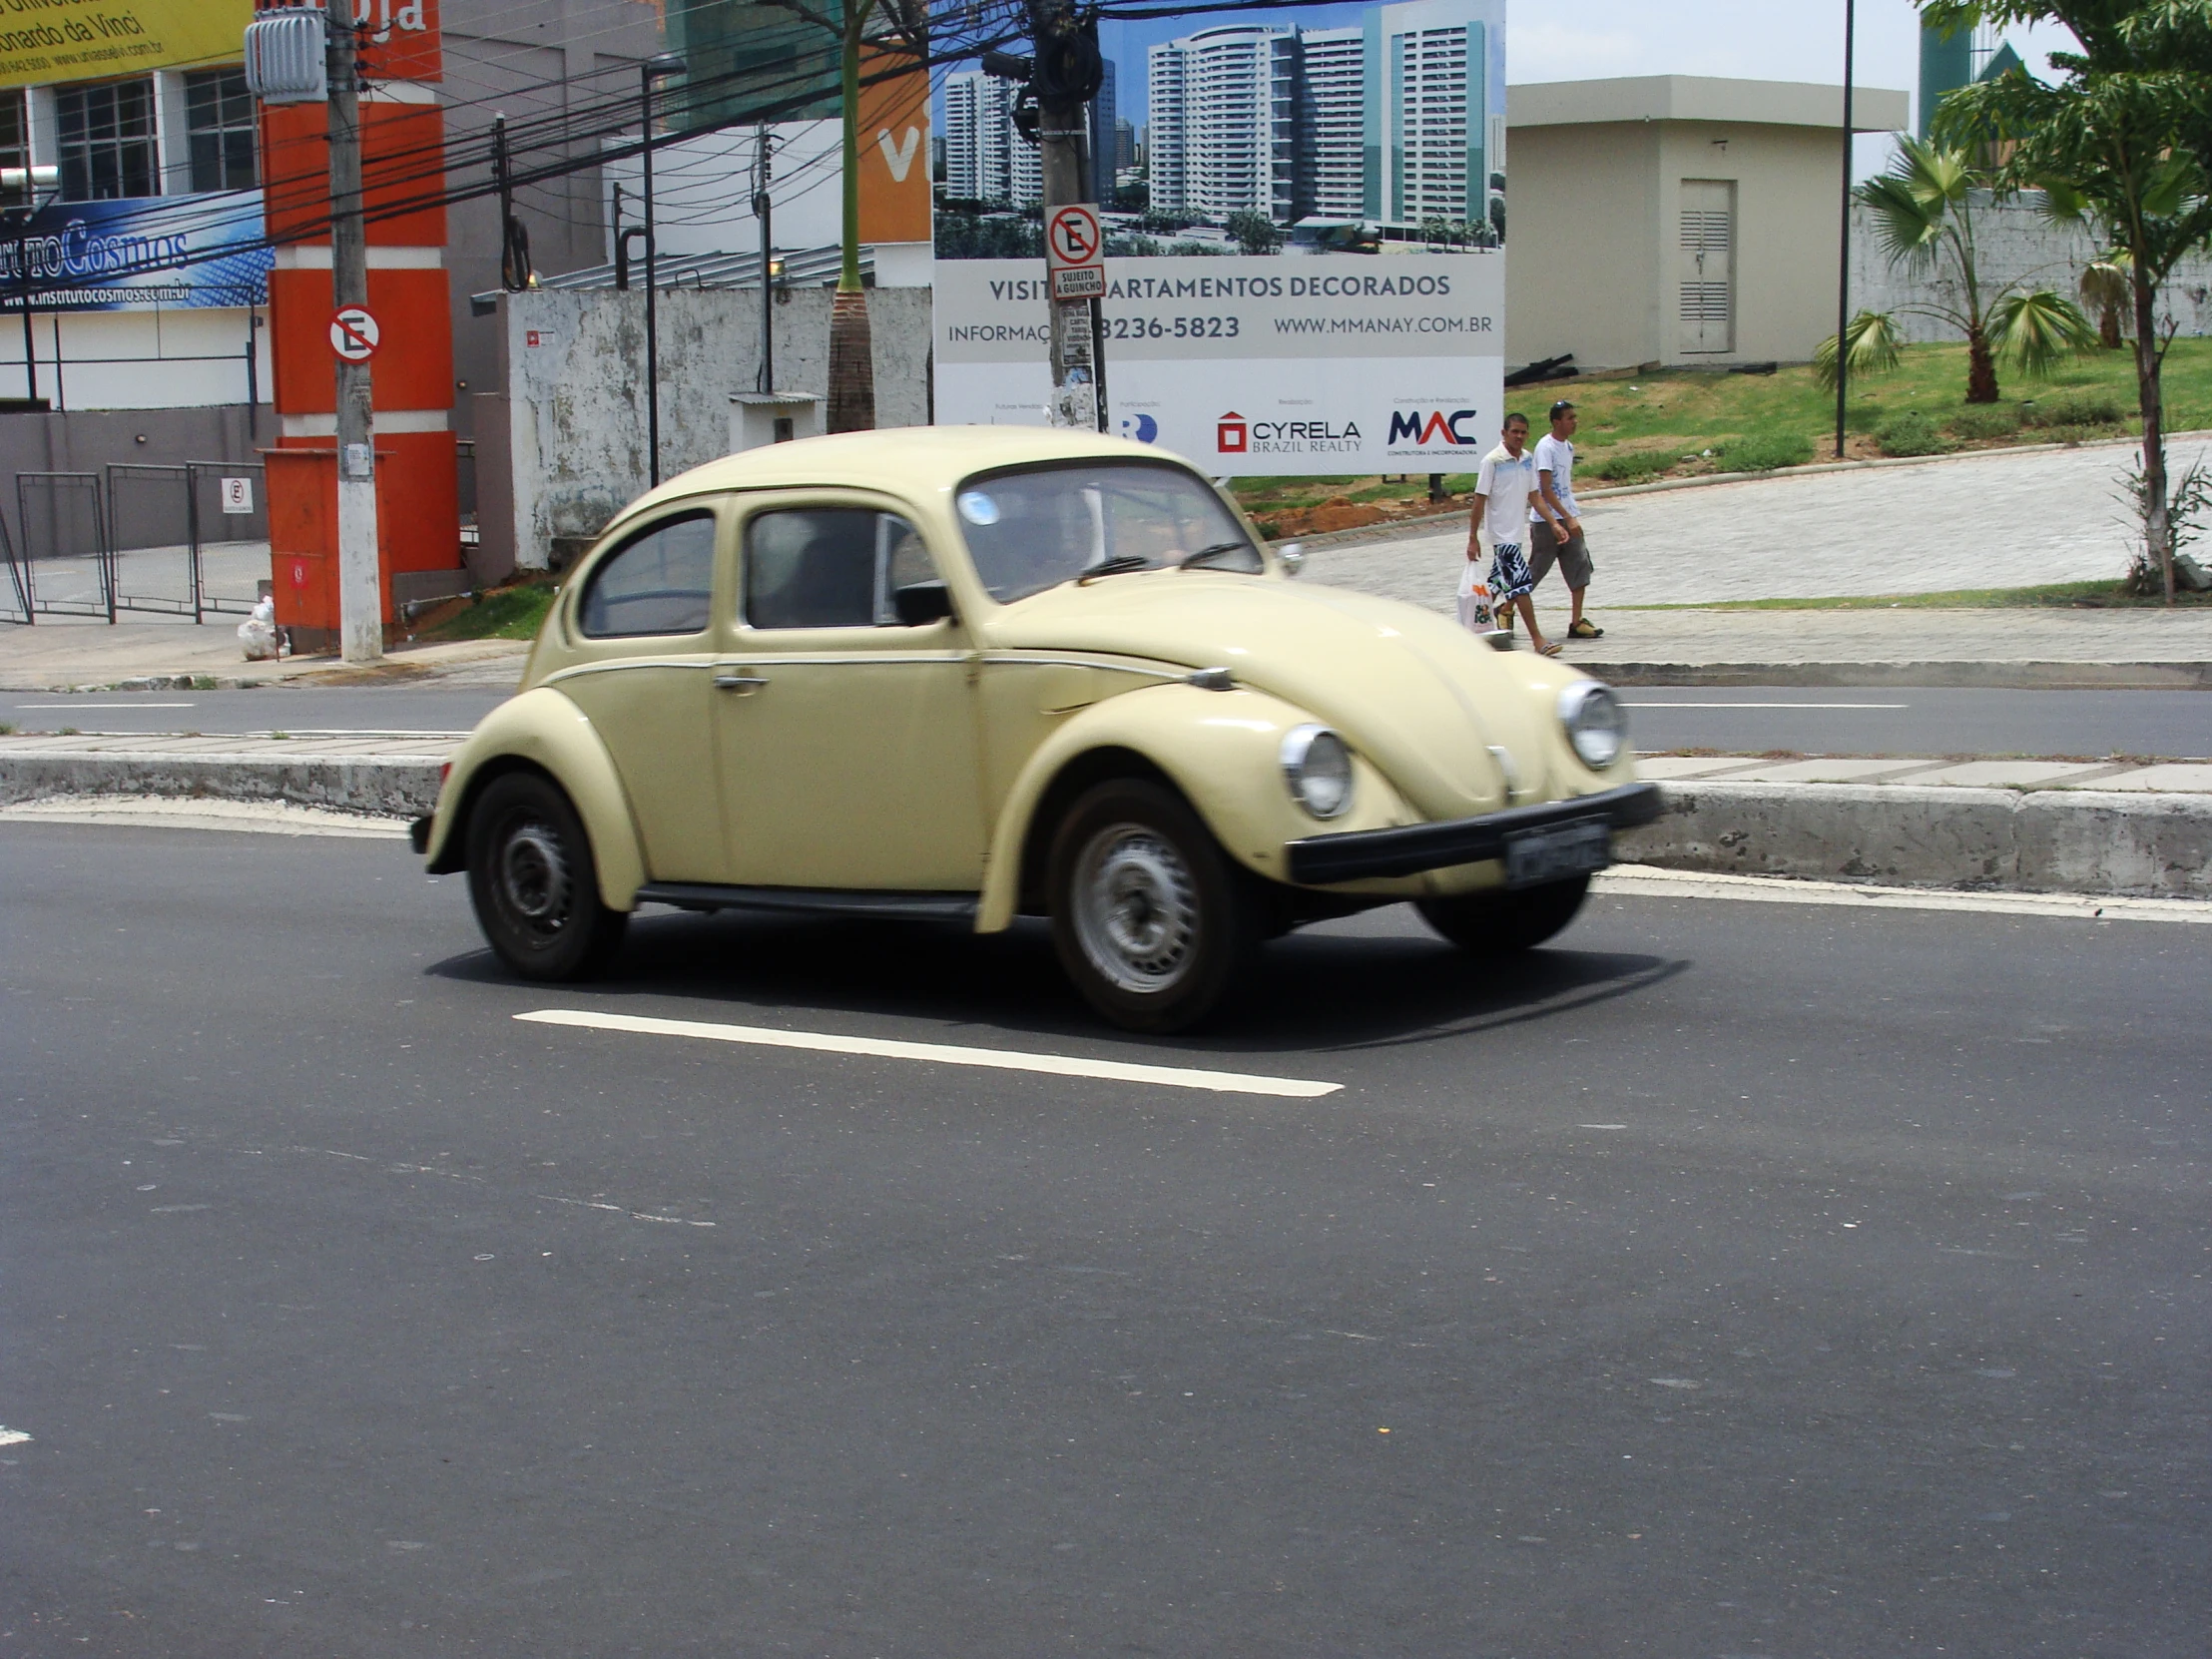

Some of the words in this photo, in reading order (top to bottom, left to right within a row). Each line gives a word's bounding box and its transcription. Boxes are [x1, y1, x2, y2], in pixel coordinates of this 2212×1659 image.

[64, 18, 96, 42] da
[86, 10, 146, 38] Vinci
[1066, 220, 1084, 252] E
[1062, 270, 1094, 282] SUJEITO
[1057, 283, 1062, 293] A
[1063, 280, 1102, 293] GUINCHO
[1290, 276, 1450, 296] DECORADOS
[342, 316, 366, 351] E
[1274, 316, 1492, 333] WWW.MMANAY.COM.BR
[1253, 421, 1362, 440] CYRELA
[1387, 409, 1477, 446] MAC
[1253, 440, 1304, 453] BRAZIL
[1310, 439, 1363, 452] REALTY
